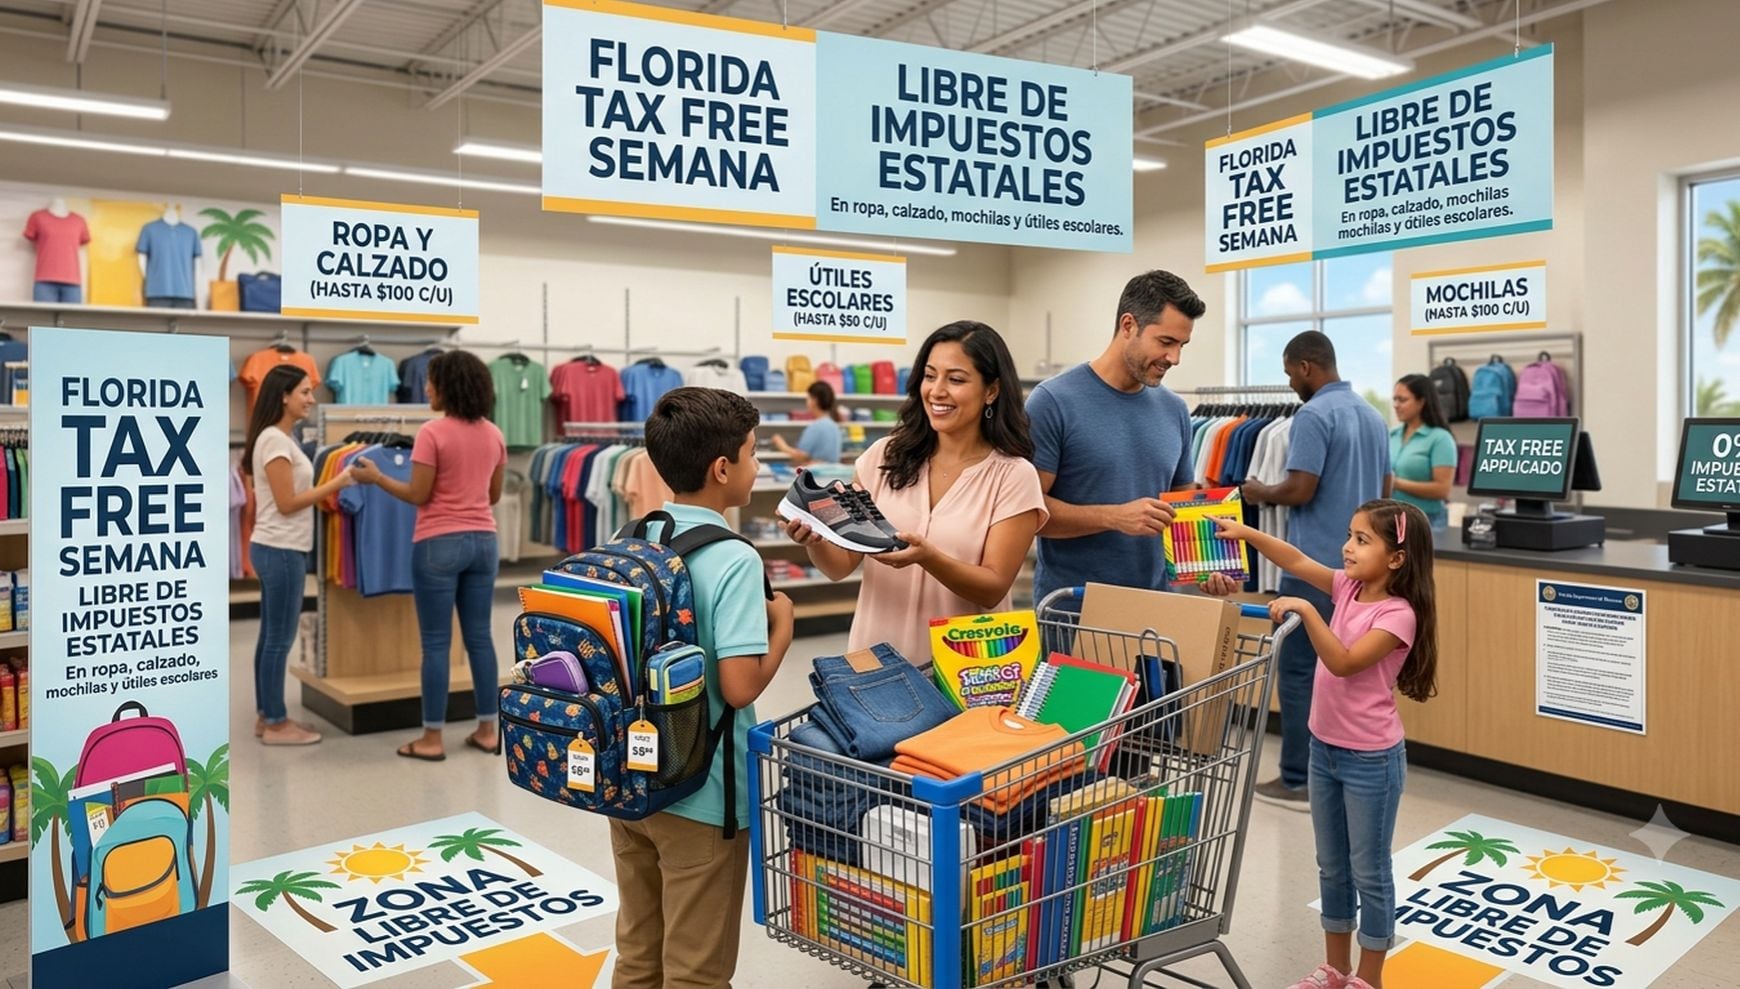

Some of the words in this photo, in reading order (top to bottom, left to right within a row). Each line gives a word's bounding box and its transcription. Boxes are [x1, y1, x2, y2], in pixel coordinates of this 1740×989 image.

[591, 38, 780, 100] FLORIDA
[898, 63, 1008, 114] LIBRE
[1021, 80, 1068, 121] DE
[576, 85, 666, 135] TAX
[682, 97, 789, 147] FREE
[1356, 95, 1439, 141] LIBRE
[1450, 81, 1492, 119] DE
[872, 105, 1092, 165] IMPUESTOS
[1338, 111, 1517, 175] IMPUESTOS
[589, 136, 780, 192] SEMANA
[1219, 138, 1297, 173] FLORIDA
[879, 150, 1085, 207] ESTATALES
[1229, 163, 1286, 199] TAX
[1345, 148, 1510, 204] ESTATALES
[831, 197, 849, 212] En
[853, 202, 888, 219] ropa,
[892, 203, 948, 222] calzado,
[951, 209, 1011, 227] mochilas
[1013, 216, 1022, 230] y
[1025, 213, 1060, 230] útiles
[1062, 219, 1124, 236] escolares.
[1223, 192, 1293, 229] FREE
[1338, 222, 1391, 239] mochilas
[1393, 221, 1402, 235] y
[1443, 205, 1514, 225] escolares.
[1341, 210, 1356, 223] En
[1359, 207, 1389, 223] ropa,
[1391, 196, 1443, 216] calzado,
[1446, 187, 1509, 207] mochilas
[333, 221, 409, 250] ROPA
[416, 227, 433, 251] Y
[1219, 223, 1298, 252] SEMANA
[317, 250, 448, 281] CALZADO
[810, 262, 872, 289] ÚTILES
[311, 280, 372, 299] (HASTA
[377, 283, 414, 301] $100
[419, 286, 453, 306] C/U)
[787, 288, 894, 312] ESCOLARES
[1426, 277, 1528, 304] MOCHILAS
[794, 312, 836, 327] (HASTA
[839, 313, 860, 328] $50
[863, 315, 887, 331] C/U)
[1471, 304, 1499, 318] $100
[1503, 300, 1530, 316] C/U)
[62, 377, 204, 408] FLORIDA
[61, 415, 202, 478] TAX
[1485, 439, 1517, 455] TAX
[1520, 439, 1563, 456] FREE
[1479, 458, 1562, 475] APPLICADO
[61, 484, 205, 539] FREE
[59, 540, 206, 577] SEMANA
[79, 581, 149, 607] LIBRE
[156, 579, 187, 601] DE
[62, 602, 203, 633] IMPUESTOS
[67, 625, 199, 657] ESTATALES
[46, 680, 108, 699] mochilas
[110, 681, 119, 695] y
[160, 669, 218, 687] escolares
[66, 665, 87, 680] En
[92, 663, 132, 679] ropa,
[136, 652, 200, 672] calzado,
[333, 868, 516, 923] ZONA
[353, 899, 488, 944] LIBRE
[481, 882, 549, 919] DE
[1438, 870, 1615, 936] ZONA
[343, 889, 604, 972] IMPUESTOS
[1406, 888, 1538, 936] LIBRE
[1537, 925, 1610, 957] DE
